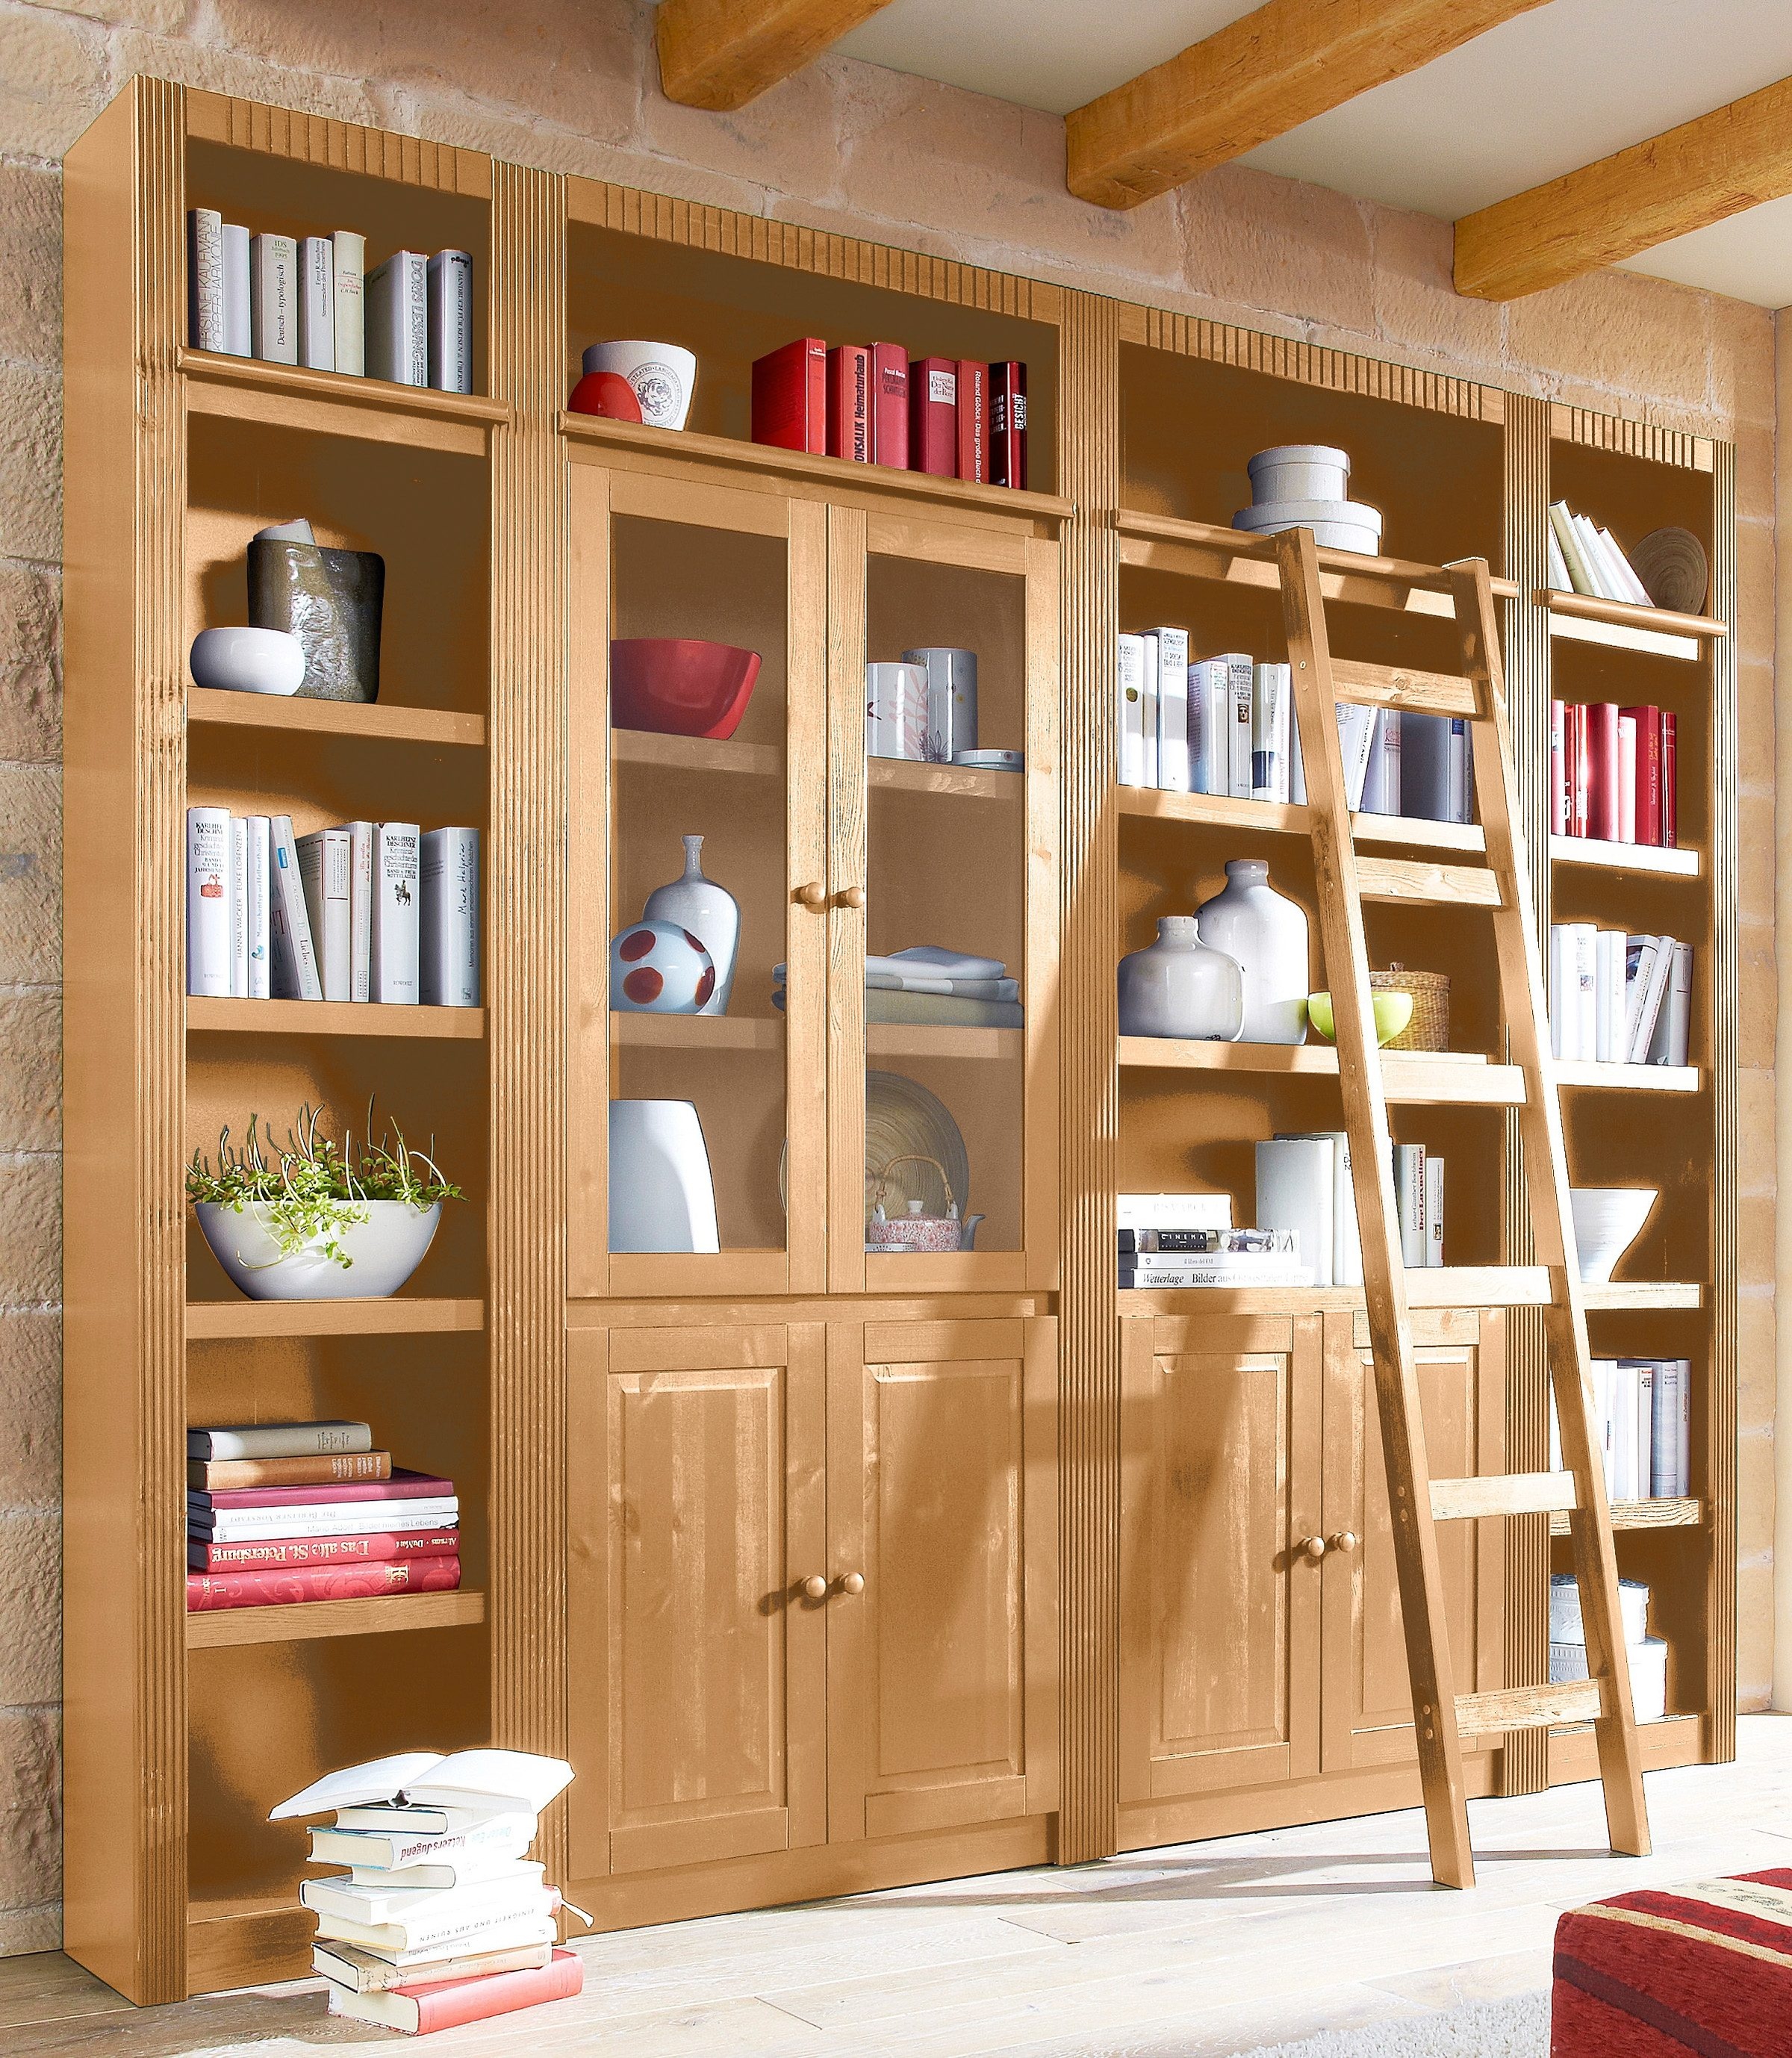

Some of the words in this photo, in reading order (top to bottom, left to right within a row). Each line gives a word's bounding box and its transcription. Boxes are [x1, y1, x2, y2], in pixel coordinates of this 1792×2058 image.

[198, 211, 211, 290] KAUFMANN
[275, 240, 287, 248] IDS
[277, 264, 287, 308] typologisch
[411, 261, 423, 302] DORIS
[277, 314, 285, 346] Deutsch
[411, 305, 423, 361] LESSING
[854, 355, 865, 419] Heimaturlaub
[457, 842, 469, 882] Helprin
[458, 888, 467, 915] Mark
[1160, 1232, 1205, 1240] CINEMA
[1143, 1273, 1184, 1285] Wetterlage
[1192, 1273, 1216, 1284] Bilder
[1218, 1275, 1231, 1283] aus
[211, 1546, 287, 1564] Petersburg
[289, 1544, 309, 1561] St.
[311, 1542, 338, 1558] alte
[341, 1540, 370, 1556] Das
[434, 1835, 466, 1850] Ketzers
[400, 1842, 433, 1861] Jugend
[474, 1919, 491, 1929] UND
[495, 1909, 535, 1924] EINIGKEIT
[455, 1925, 470, 1934] AUS
